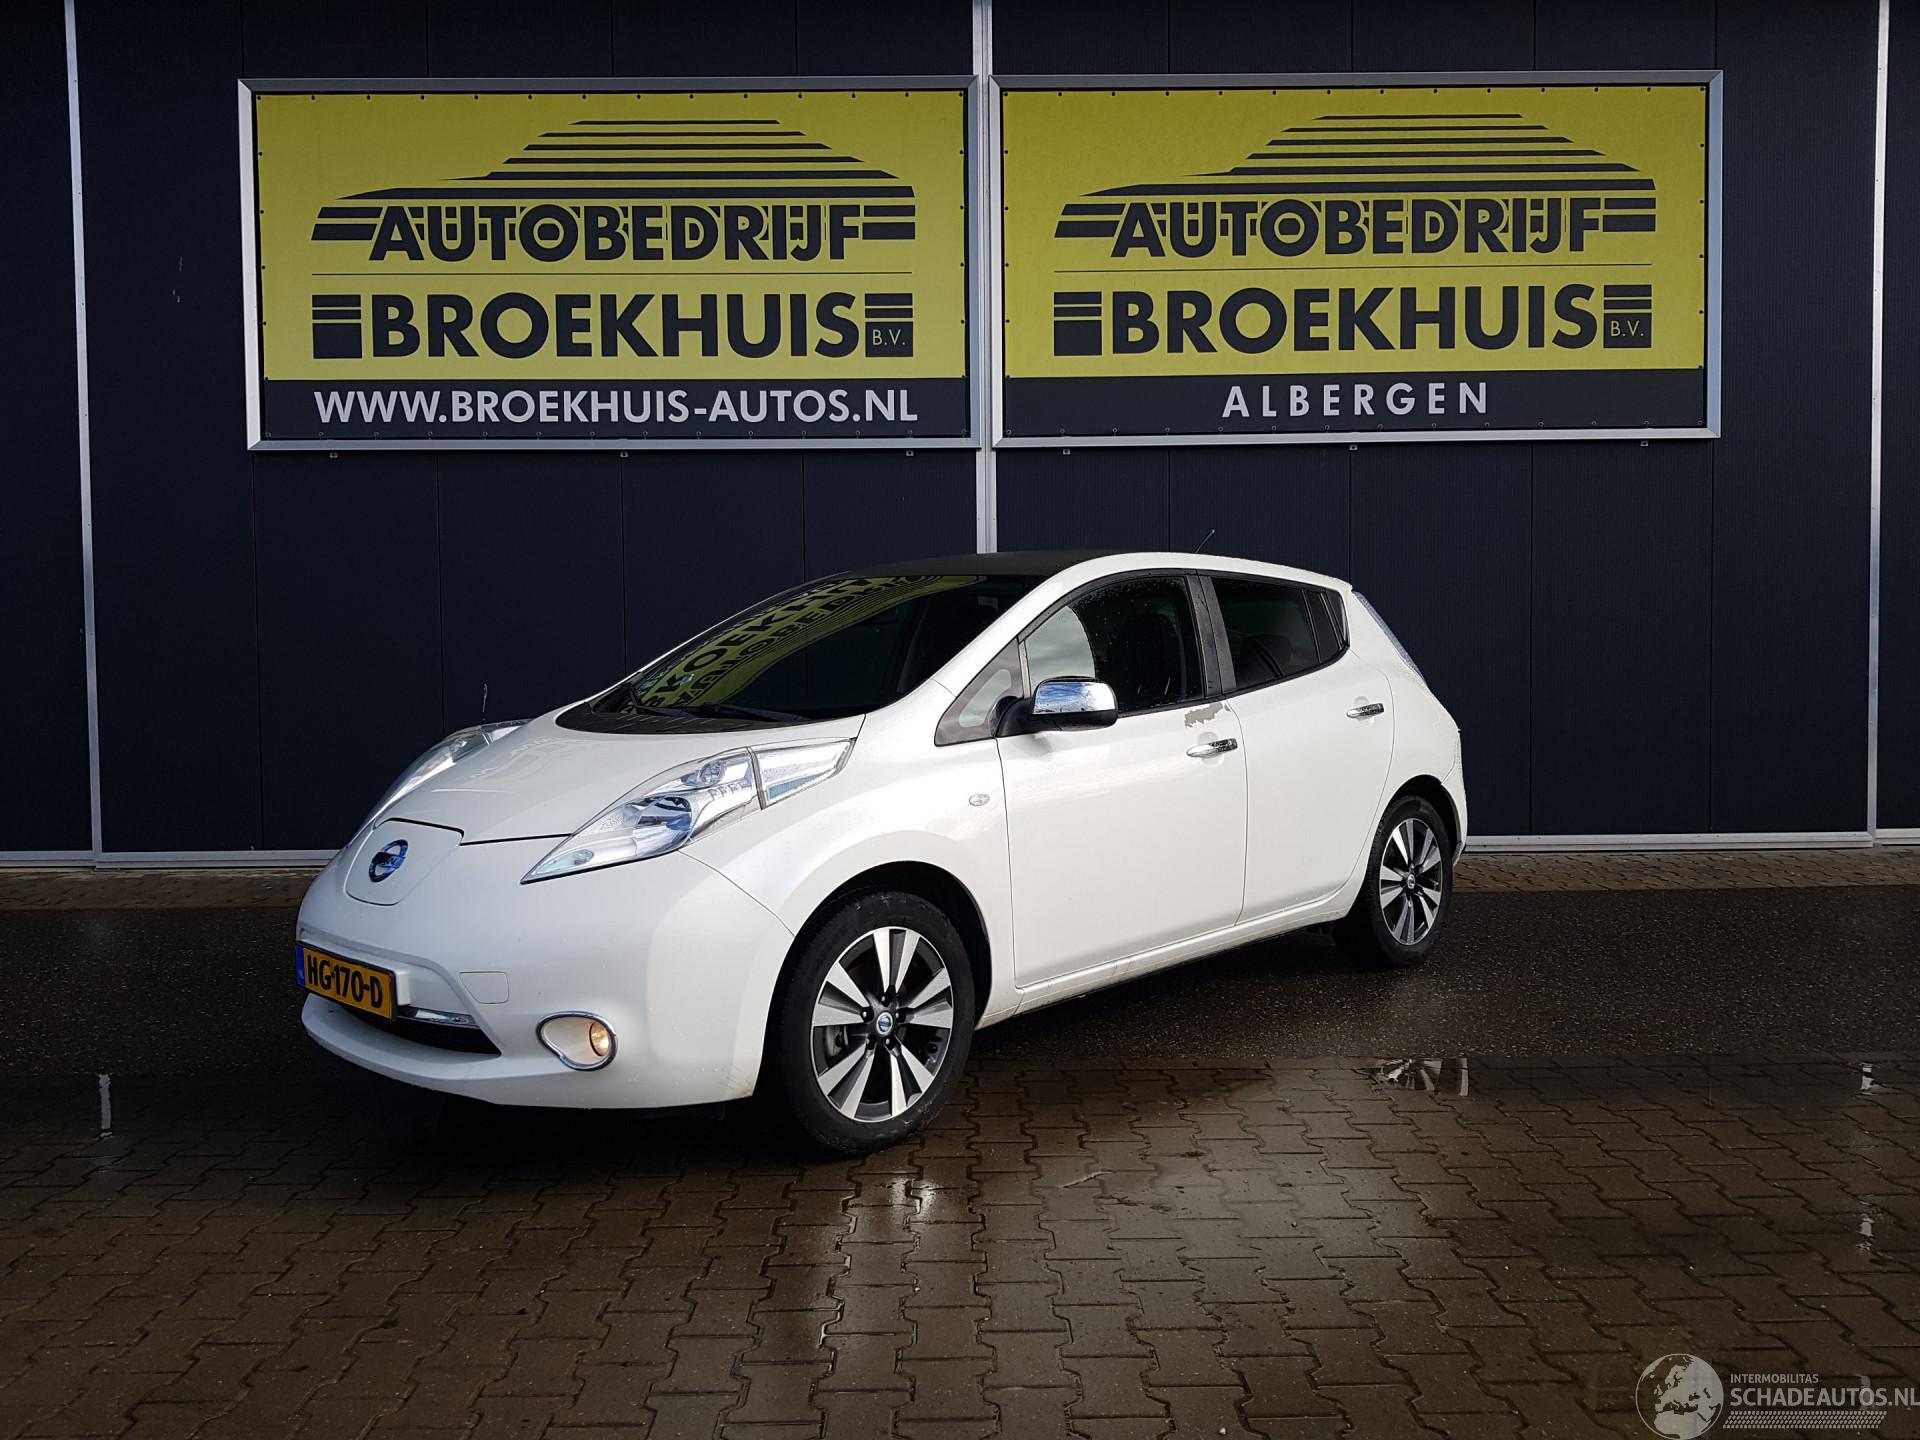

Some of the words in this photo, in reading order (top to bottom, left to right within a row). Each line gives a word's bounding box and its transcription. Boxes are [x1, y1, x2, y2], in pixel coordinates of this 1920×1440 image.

[369, 204, 862, 261] AUTOBEDRIJF
[1111, 198, 1600, 257] AUTOBEDRIJF
[372, 292, 859, 359] BROEKHUIS
[871, 329, 907, 347] B.V.
[1112, 284, 1599, 355] BROEKHUIS
[1609, 322, 1645, 339] B.V.
[314, 390, 918, 424] WWW.BROEKHUIS-AUTOS.NL
[1222, 382, 1488, 418] ALBERGEN
[307, 955, 383, 1009] HG-170-D
